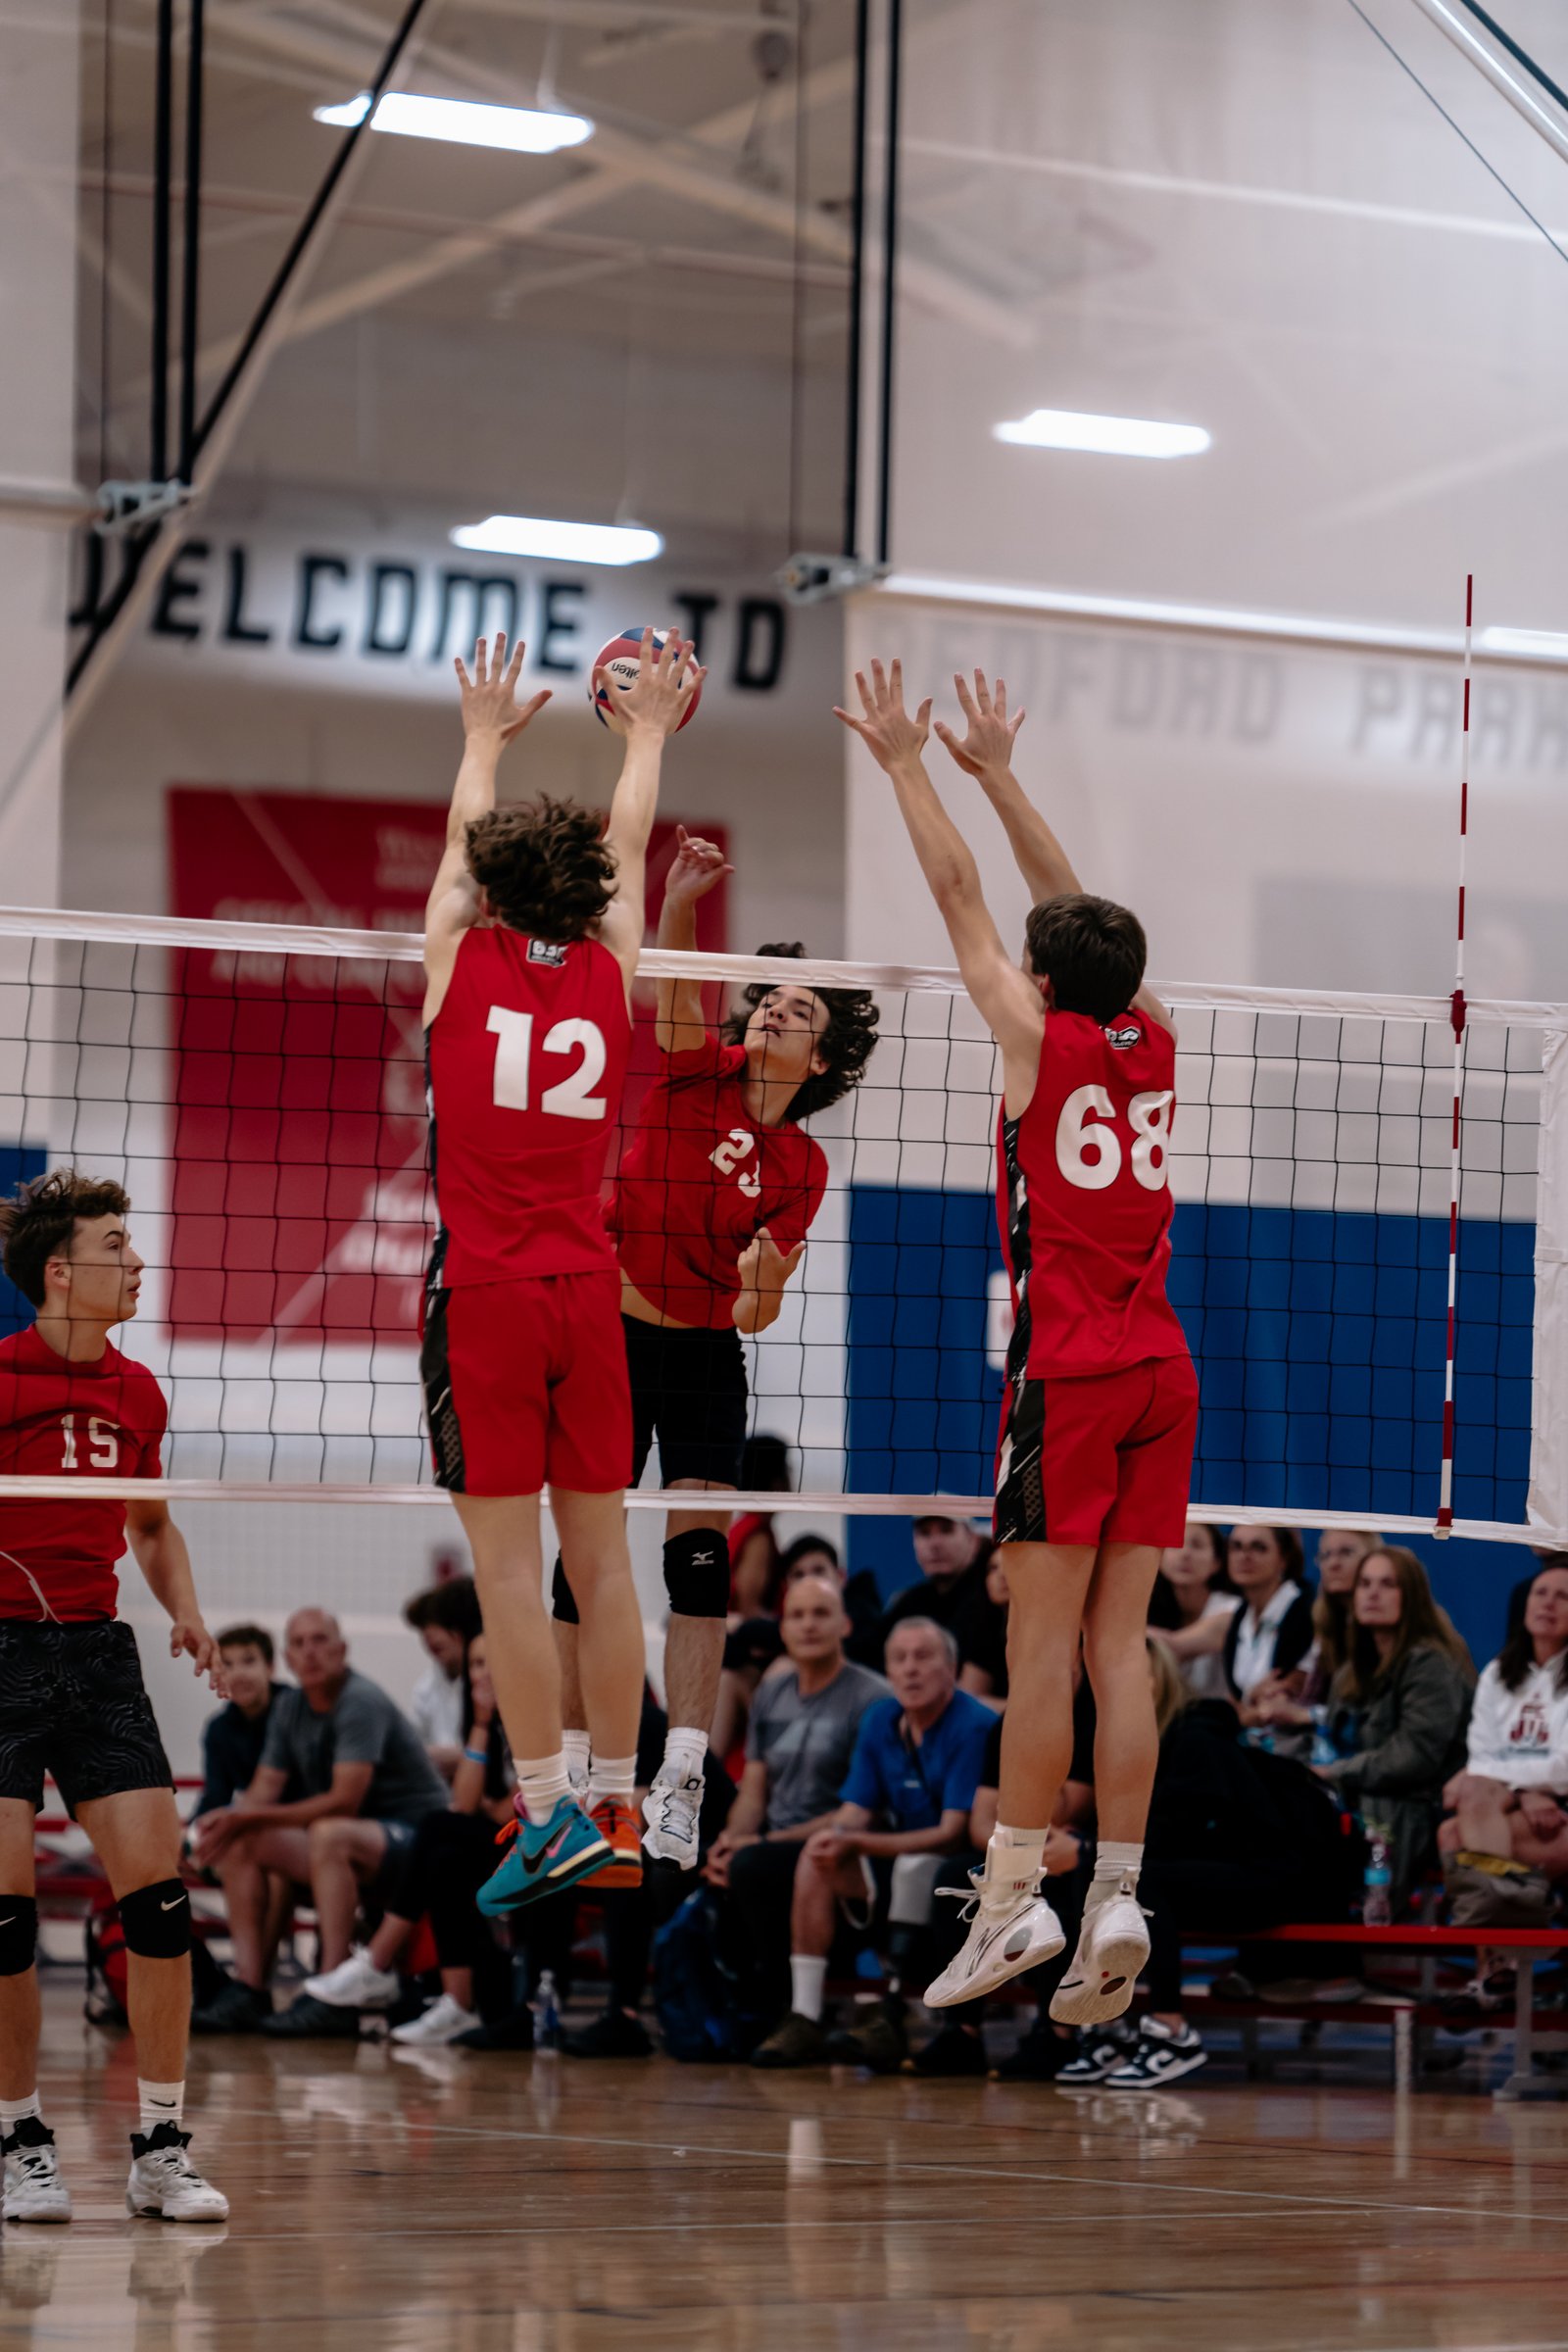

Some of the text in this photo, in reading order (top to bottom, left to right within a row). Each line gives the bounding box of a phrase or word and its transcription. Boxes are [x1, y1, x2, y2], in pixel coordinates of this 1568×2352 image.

[612, 662, 640, 679] olten
[672, 591, 789, 693] TO
[486, 1005, 608, 1120] 12
[1055, 1084, 1174, 1191] 68
[61, 1414, 121, 1468] 15
